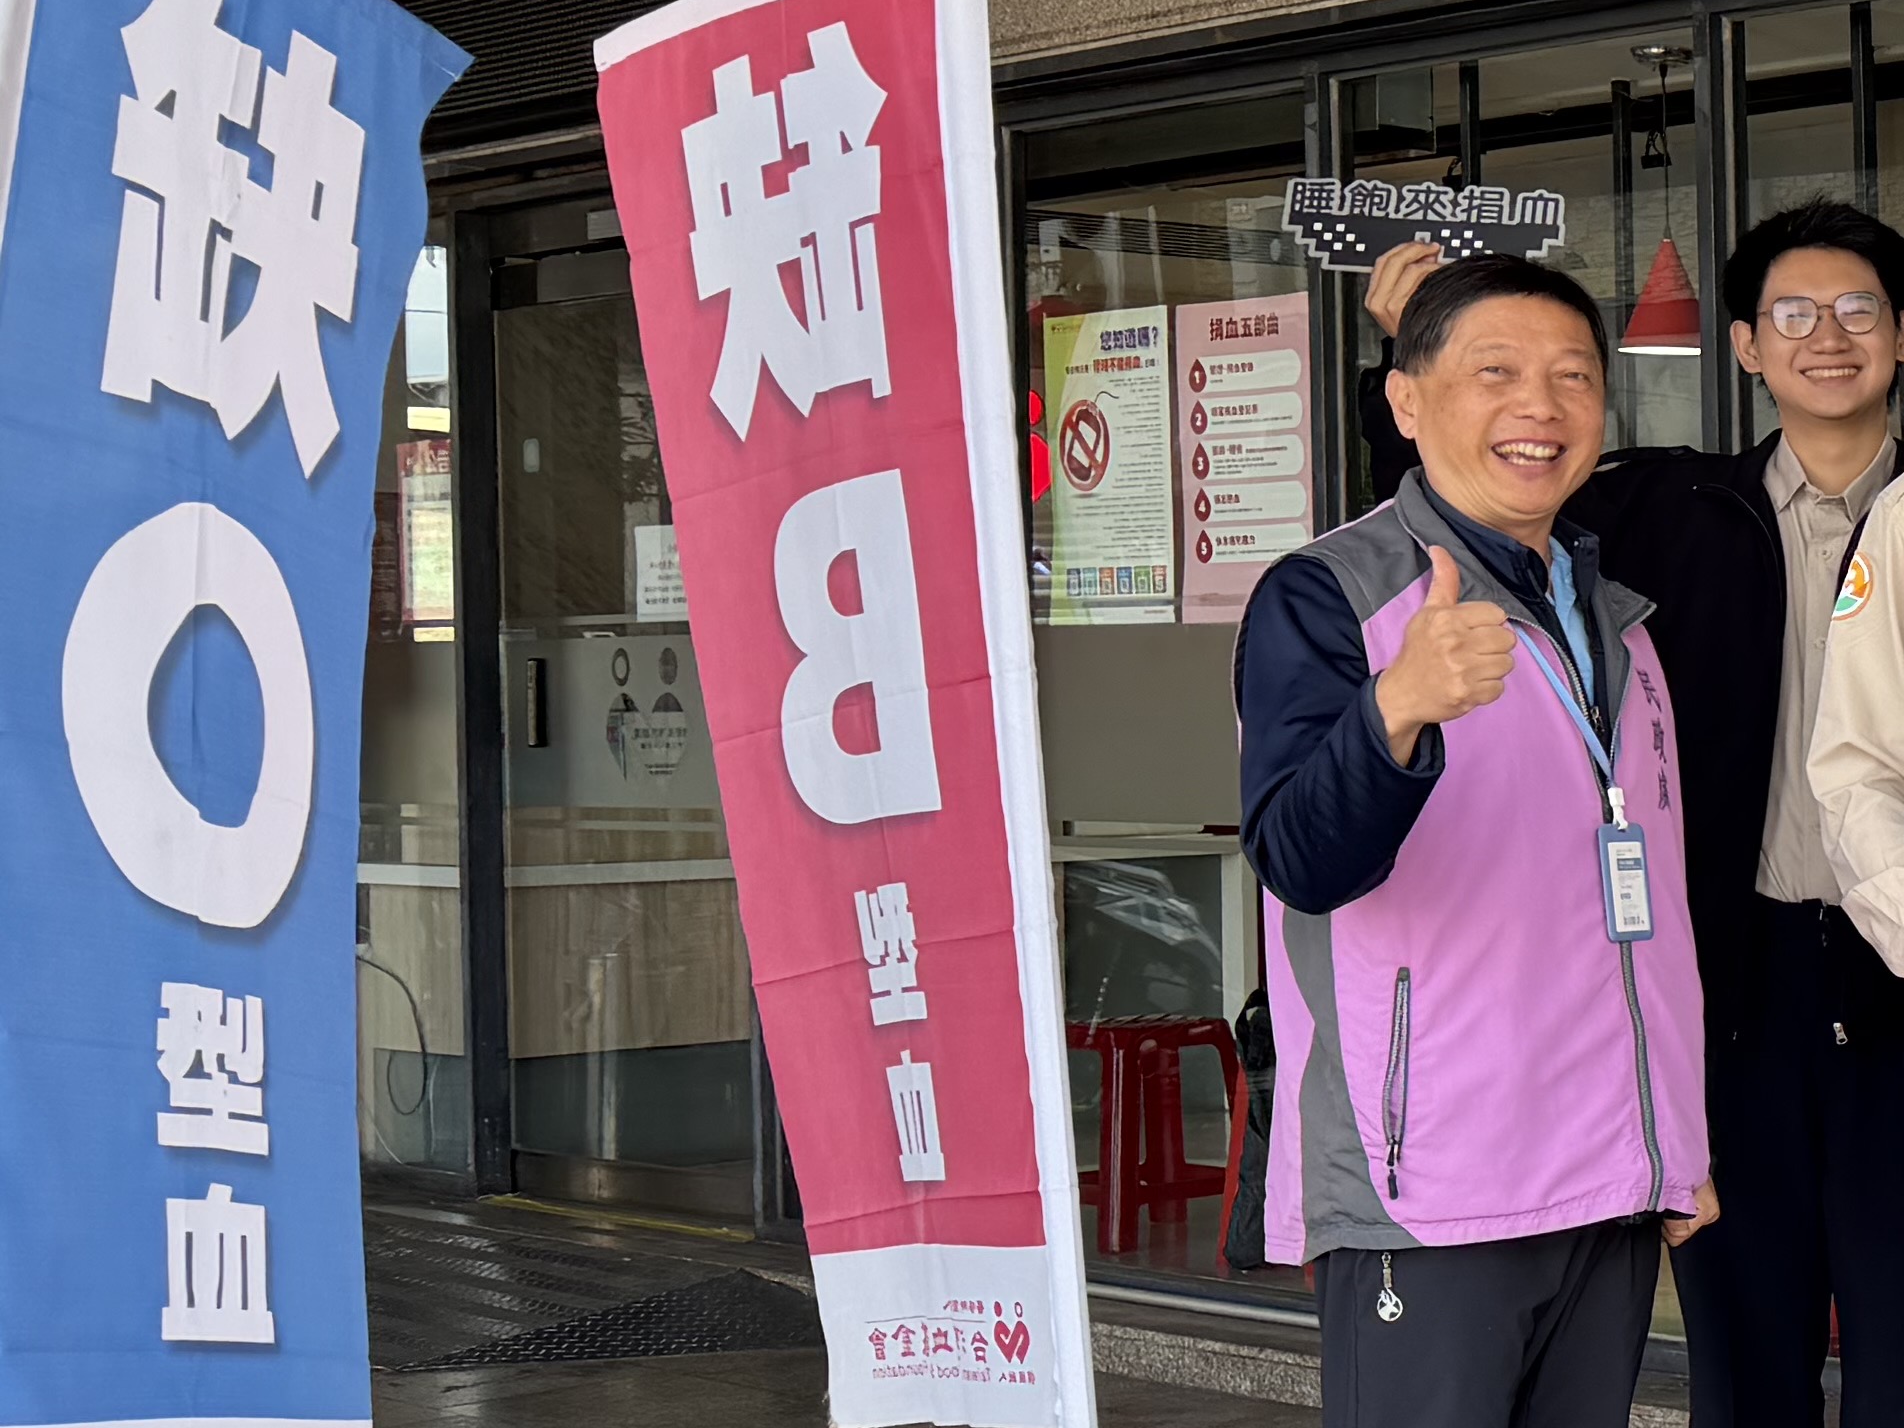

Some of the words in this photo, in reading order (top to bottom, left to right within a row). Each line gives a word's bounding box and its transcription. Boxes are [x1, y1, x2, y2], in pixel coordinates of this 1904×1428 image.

[1290, 179, 1562, 225] 睡飽來捐血
[1208, 313, 1280, 343] 捐血五部曲
